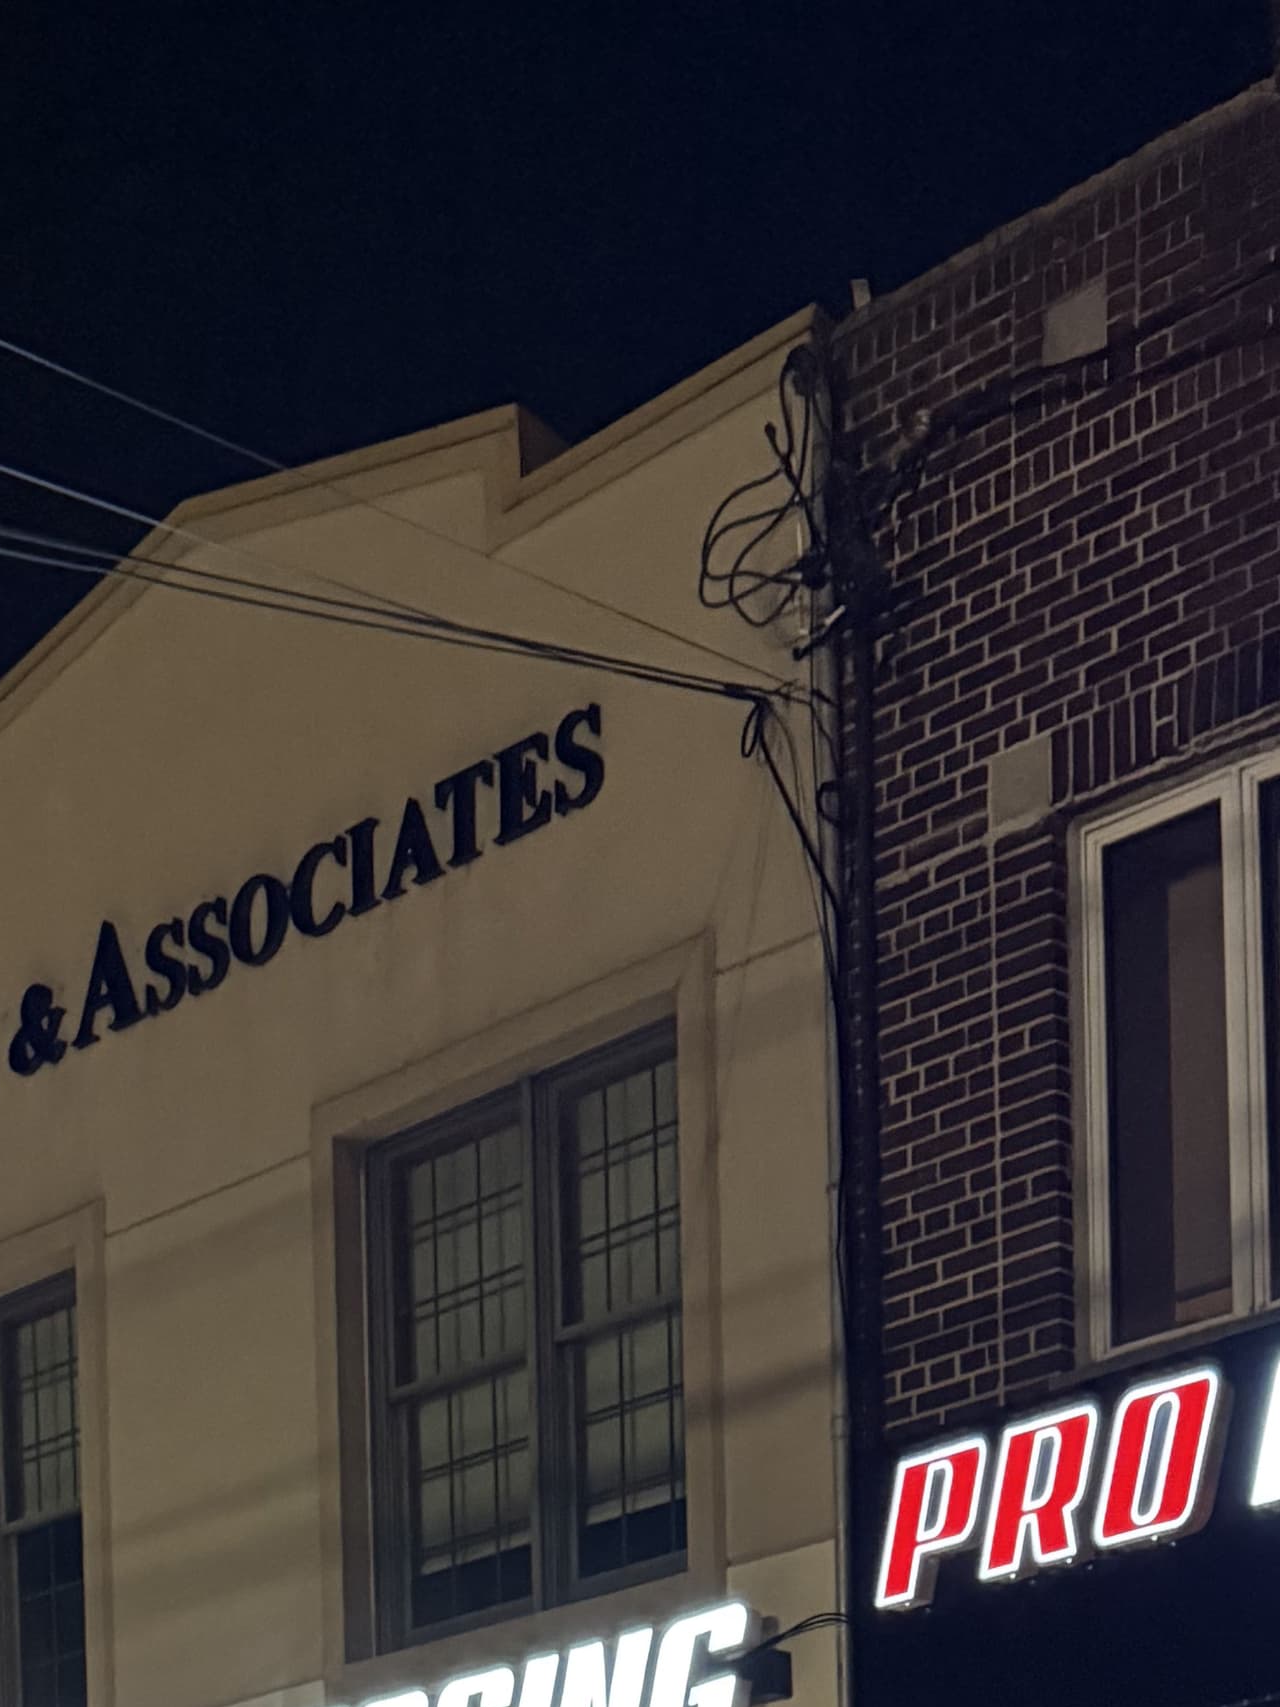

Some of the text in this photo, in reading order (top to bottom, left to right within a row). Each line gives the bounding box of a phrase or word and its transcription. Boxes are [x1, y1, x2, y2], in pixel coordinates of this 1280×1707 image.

[7, 983, 68, 1077] &
[73, 703, 606, 1048] ASSOCIATES
[874, 1369, 1221, 1612] PRO
